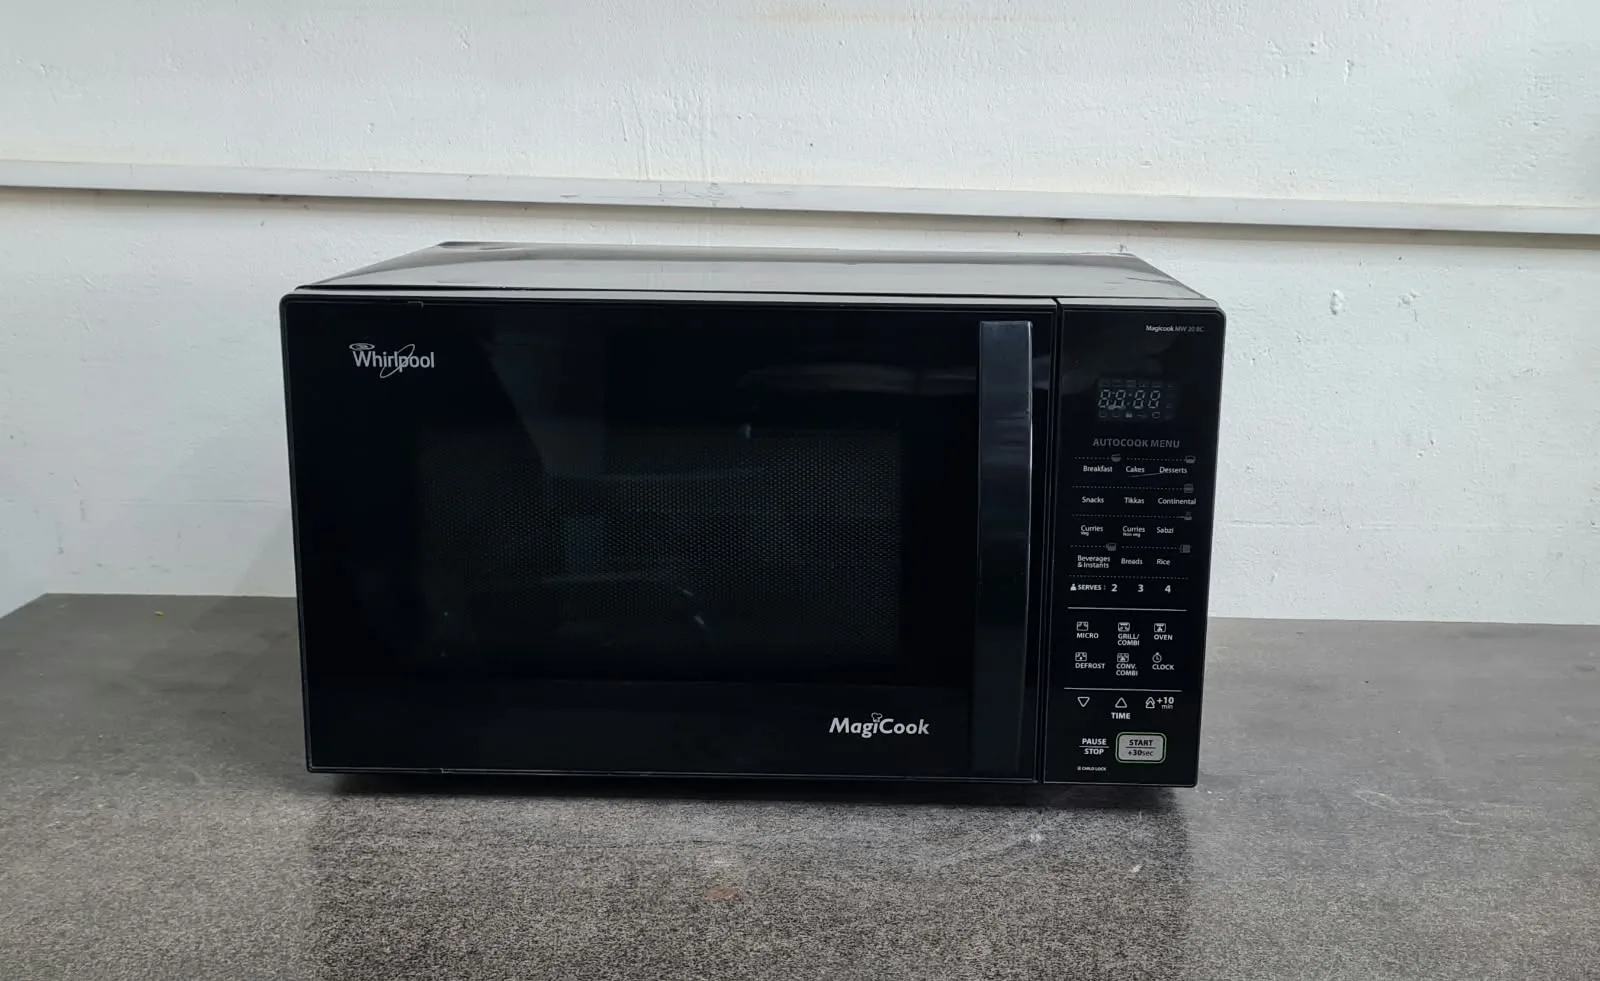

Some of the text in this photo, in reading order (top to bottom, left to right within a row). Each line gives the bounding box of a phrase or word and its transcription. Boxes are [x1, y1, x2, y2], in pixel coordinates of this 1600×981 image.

[1145, 325, 1174, 333] Magicook
[349, 342, 435, 378] Whirlpool
[1092, 438, 1180, 449] AUTOCOOK MENU
[1083, 465, 1113, 473] Breakfast
[1125, 465, 1145, 473] Cakes
[1159, 466, 1188, 474] Desserts
[1082, 496, 1104, 504] Snacks
[1124, 496, 1145, 504] Tikkas
[1157, 497, 1197, 505] Continental
[1080, 524, 1104, 532] Curries
[1122, 525, 1146, 533] Curries
[1156, 526, 1174, 534] Sabzi
[1077, 555, 1111, 563] Beverages
[1121, 557, 1143, 565] Breads
[1156, 558, 1171, 566] Rice
[1111, 583, 1118, 592] 2
[1137, 584, 1144, 592] 3
[1164, 584, 1172, 593] 4
[1156, 696, 1175, 705] +10
[1110, 712, 1131, 720] TIME
[828, 712, 930, 739] MagiCook
[1081, 738, 1108, 746] PAUSE
[1128, 739, 1154, 747] START
[1083, 748, 1105, 756] STOP
[1127, 748, 1154, 757] +30sec
